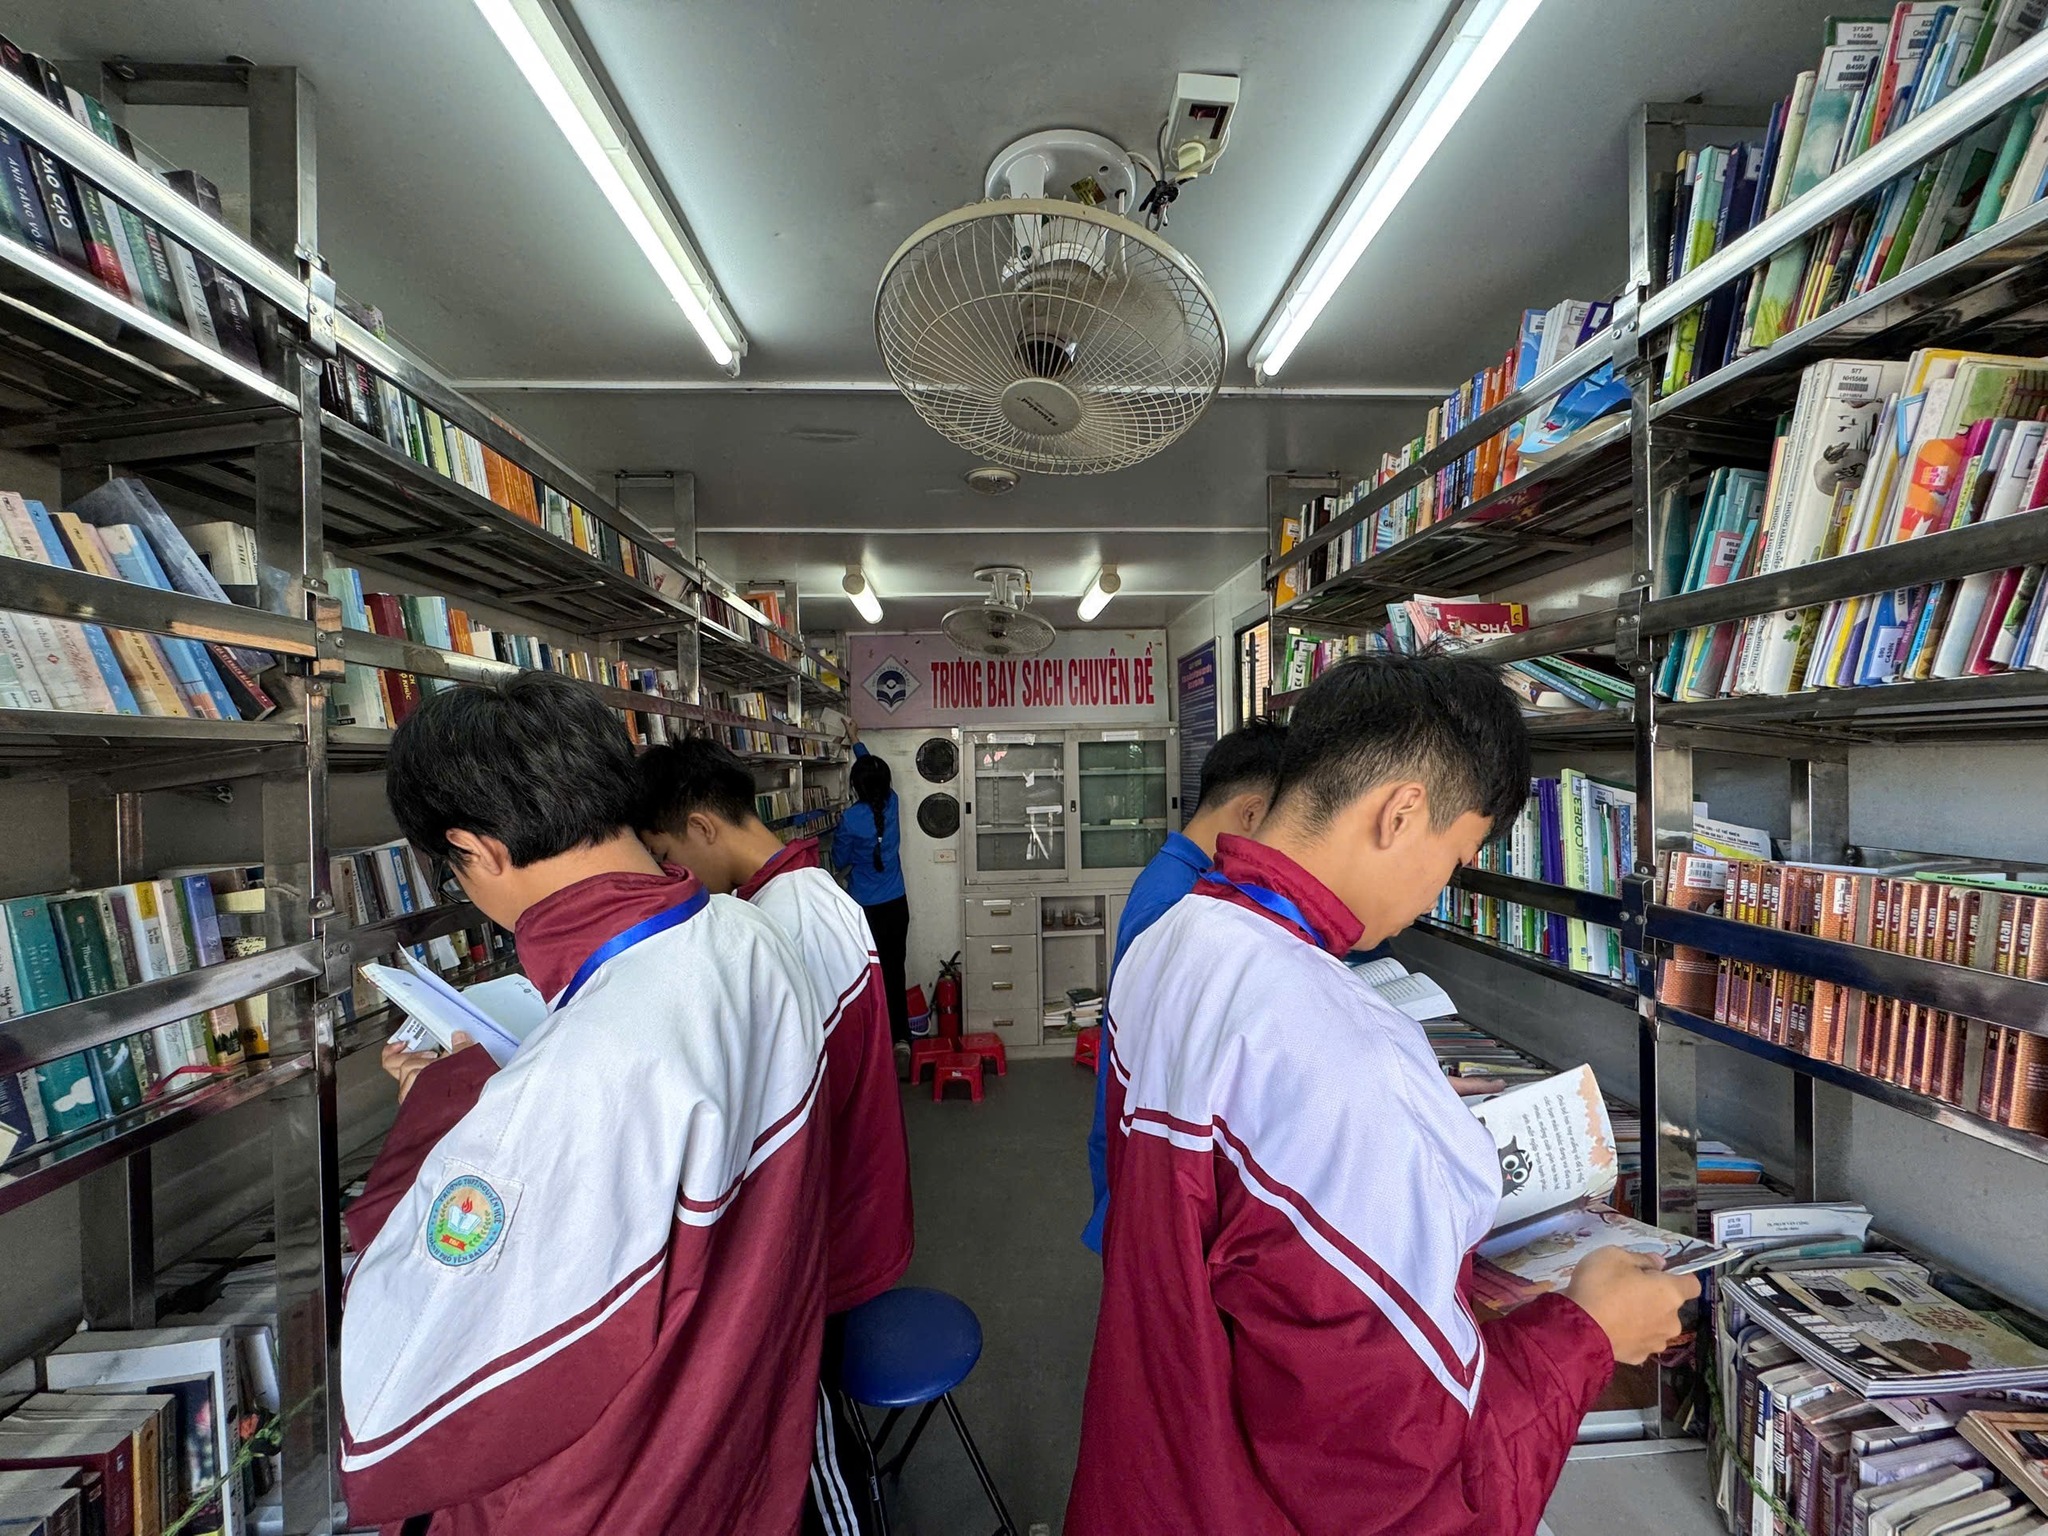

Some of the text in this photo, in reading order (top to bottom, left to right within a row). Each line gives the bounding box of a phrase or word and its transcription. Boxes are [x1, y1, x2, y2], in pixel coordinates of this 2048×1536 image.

[17, 185, 35, 219] SÁNG
[50, 193, 73, 230] CẠO
[1068, 648, 1131, 706] CHUYÊN
[1134, 642, 1155, 705] ĐỀ
[475, 1180, 499, 1208] NGUYỄN
[453, 1253, 468, 1264] YÊN
